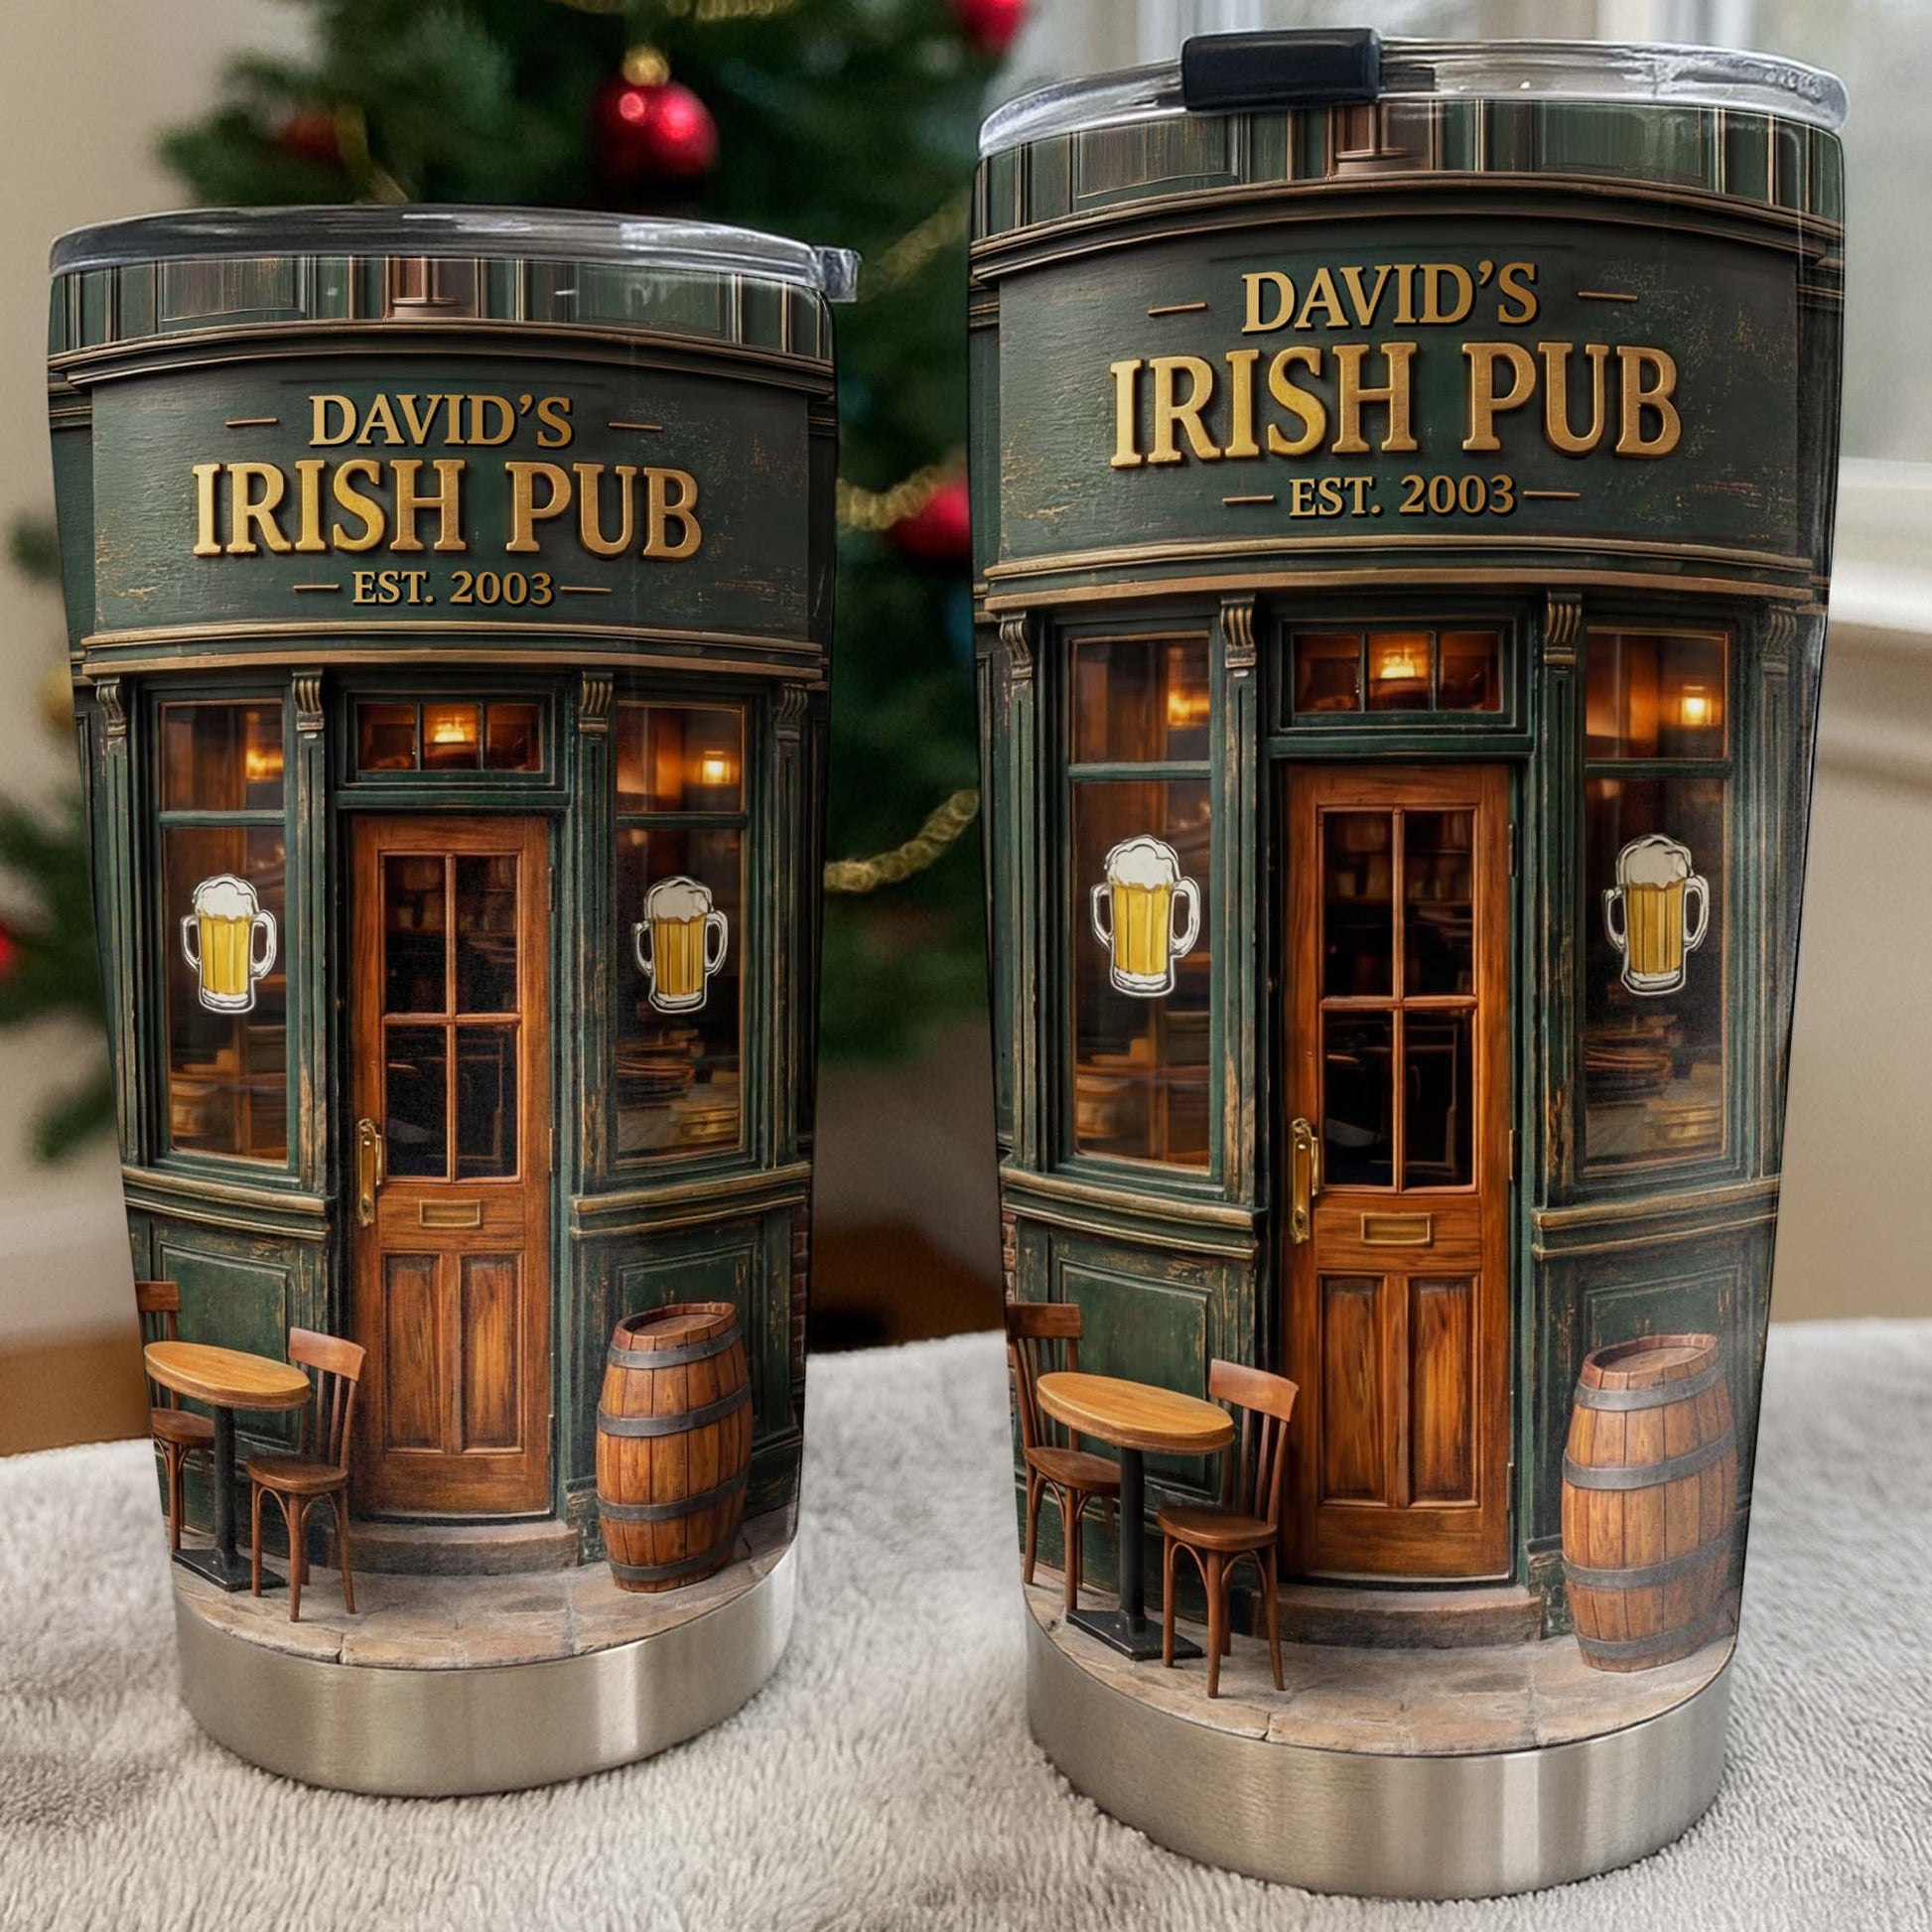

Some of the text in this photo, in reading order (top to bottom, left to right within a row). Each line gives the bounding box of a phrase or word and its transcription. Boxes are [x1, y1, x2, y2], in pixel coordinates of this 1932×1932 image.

[1241, 259, 1538, 334] DAVID’S
[309, 393, 573, 447] DAVID’S
[1110, 342, 1681, 469] IRISH PUB
[192, 459, 703, 561] IRISH PUB
[1290, 474, 1515, 516] EST. 2003
[351, 570, 554, 606] EST. 2003
